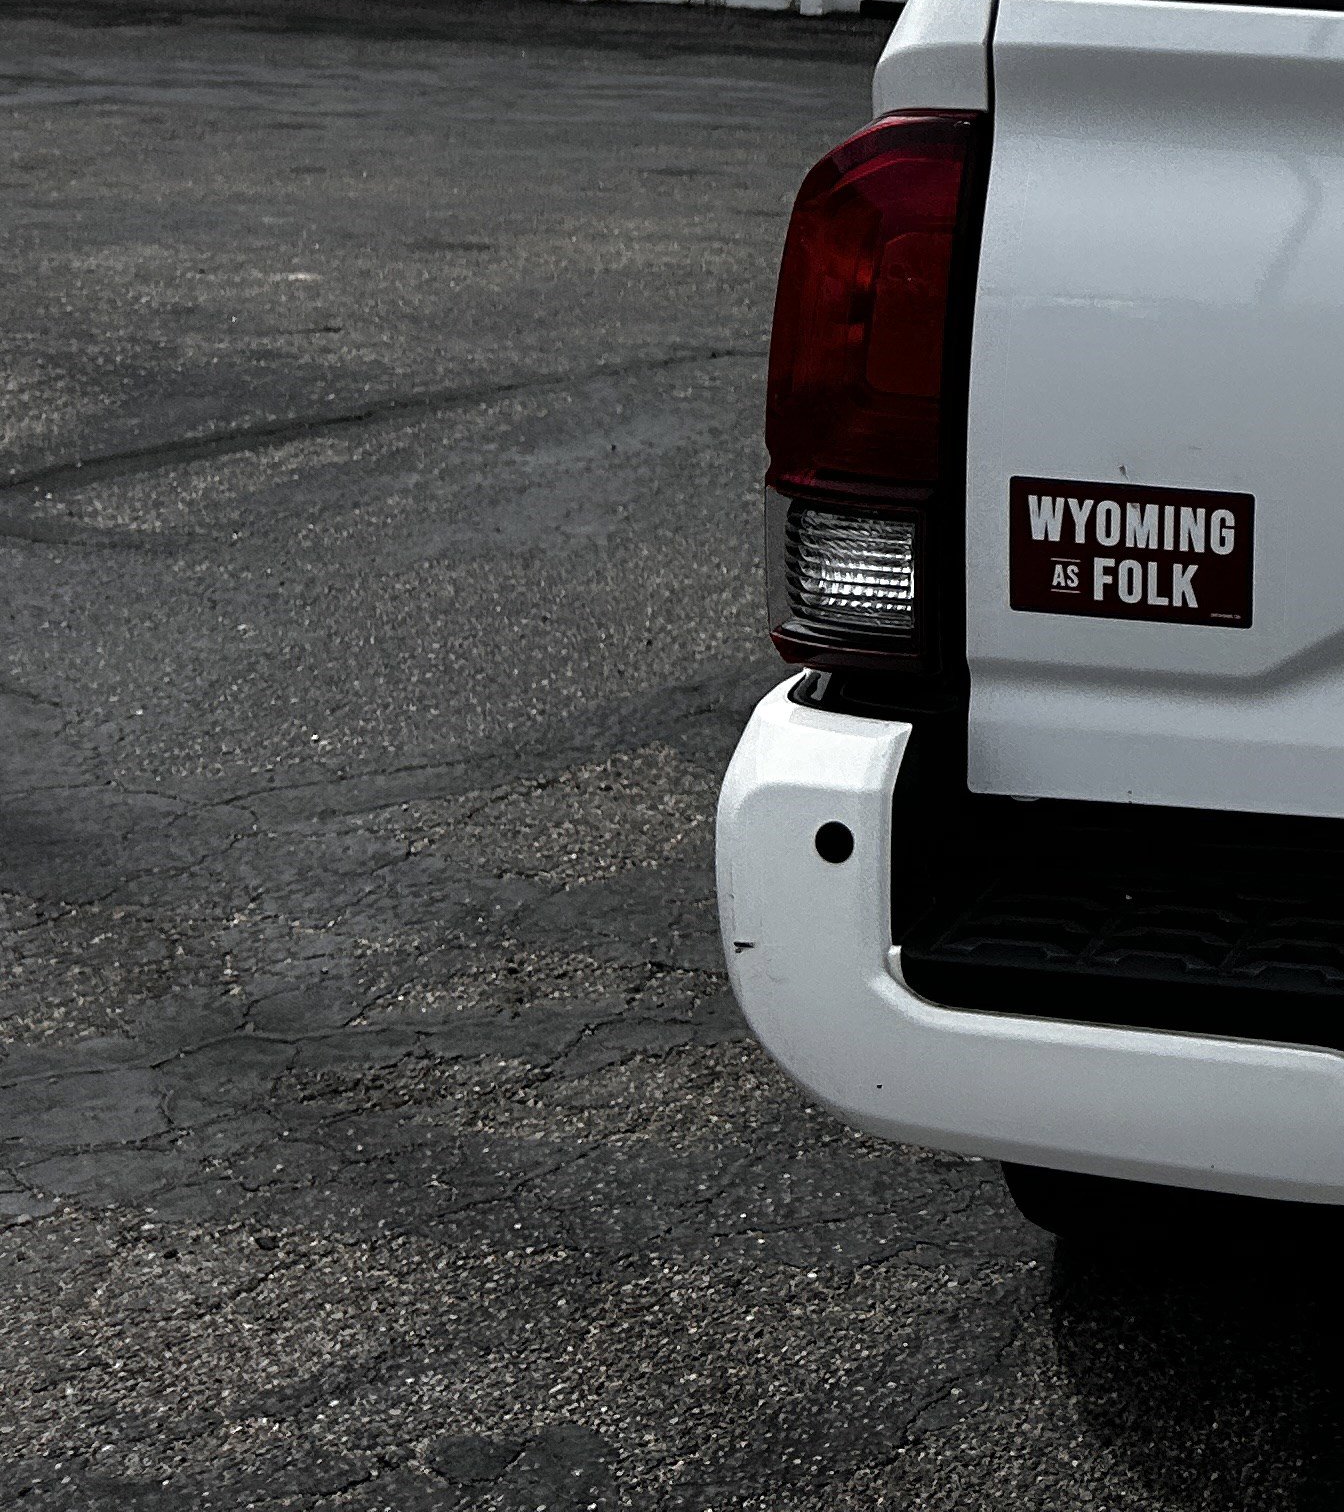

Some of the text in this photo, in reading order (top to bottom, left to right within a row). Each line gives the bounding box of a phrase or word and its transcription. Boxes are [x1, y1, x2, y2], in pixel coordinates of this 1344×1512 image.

[1027, 494, 1236, 556] WYOMING
[1051, 556, 1200, 609] AS FOLK
